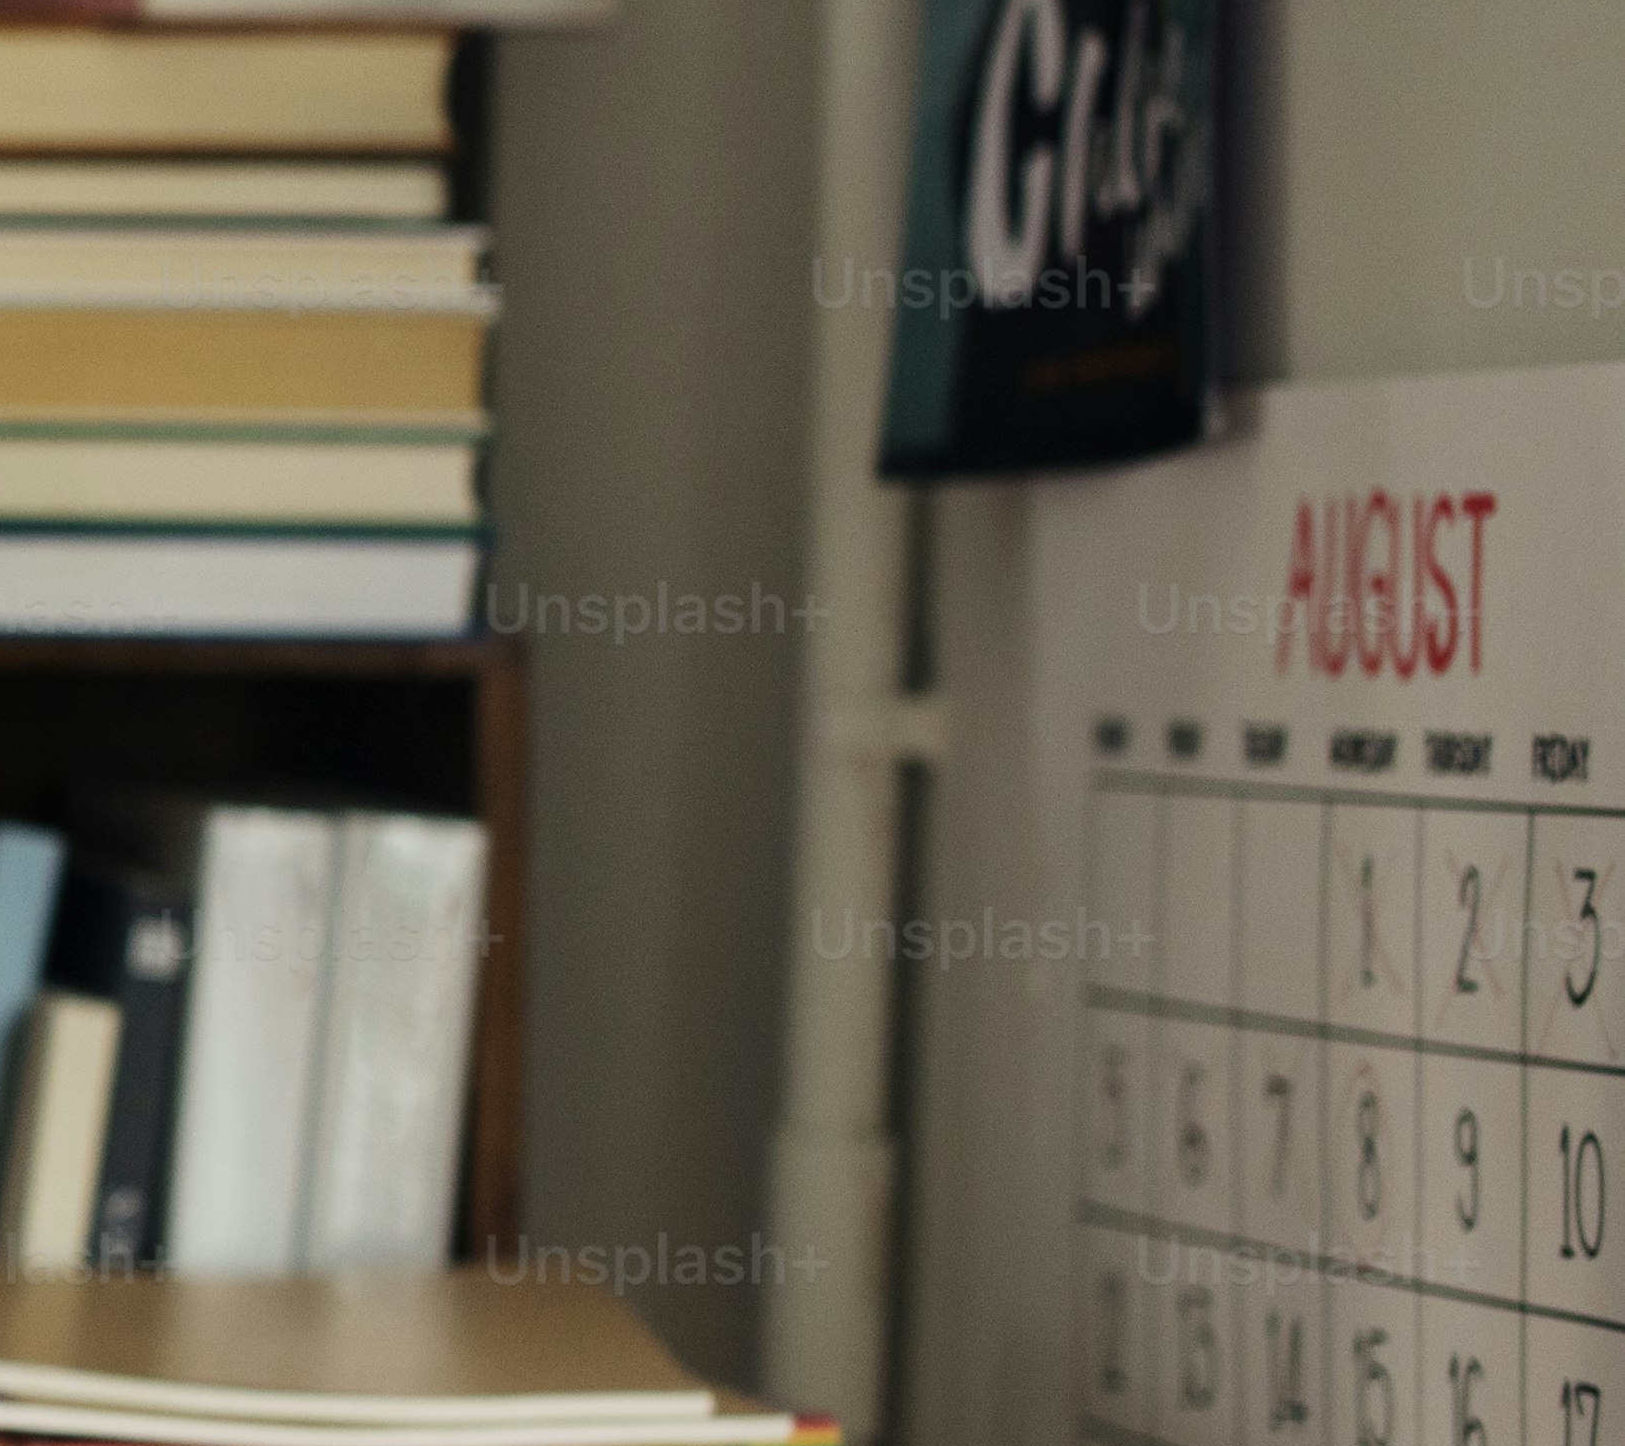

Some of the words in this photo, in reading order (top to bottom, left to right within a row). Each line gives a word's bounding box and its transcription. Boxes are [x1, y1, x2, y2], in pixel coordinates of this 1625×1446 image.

[1275, 484, 1498, 682] AUGUST
[1355, 854, 1380, 989] 1
[1453, 864, 1483, 996] 2
[1565, 867, 1604, 1008] 3
[1354, 1089, 1382, 1222] 8
[1454, 1106, 1483, 1237] 9
[1558, 1122, 1607, 1261] 10
